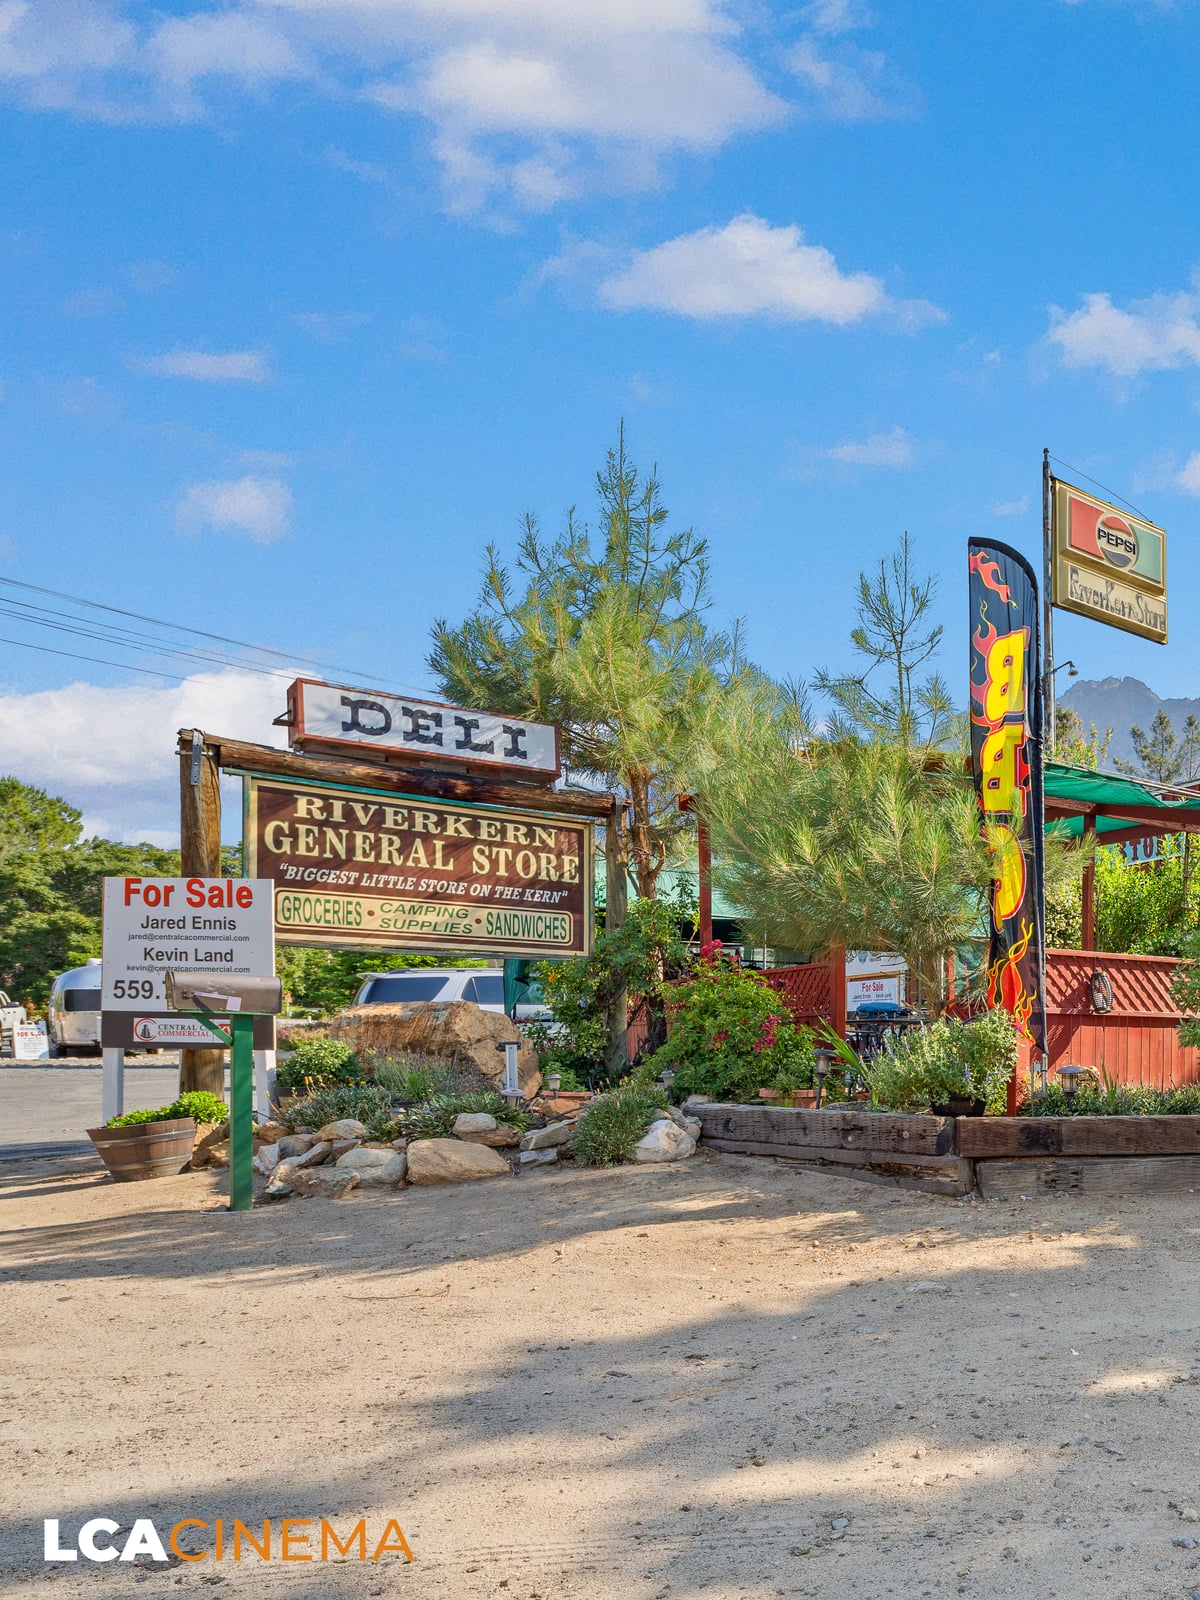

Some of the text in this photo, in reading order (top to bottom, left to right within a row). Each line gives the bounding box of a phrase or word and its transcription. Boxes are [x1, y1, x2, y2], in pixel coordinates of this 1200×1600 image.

[1097, 527, 1136, 555] PEPSI
[341, 695, 528, 760] DELI
[293, 794, 558, 849] RIVERKERN
[264, 820, 580, 884] GENERAL STORE
[124, 878, 253, 908] For Sale
[360, 873, 415, 890] LITTLE
[418, 879, 467, 894] STORE
[470, 883, 491, 897] ON
[494, 885, 523, 900] THE
[141, 915, 237, 930] Jared Ennis
[281, 895, 362, 927] GROCERIES
[380, 902, 469, 920] CAMPING
[379, 917, 473, 934] SUPPLIES
[486, 912, 567, 941] SANDWICHES
[128, 933, 250, 942] jared@centralcacommercial.com
[143, 947, 234, 962] Kevin Land
[126, 964, 250, 973] kevin@centralcacommercial.com
[113, 979, 167, 999] 559.
[861, 983, 871, 992] For
